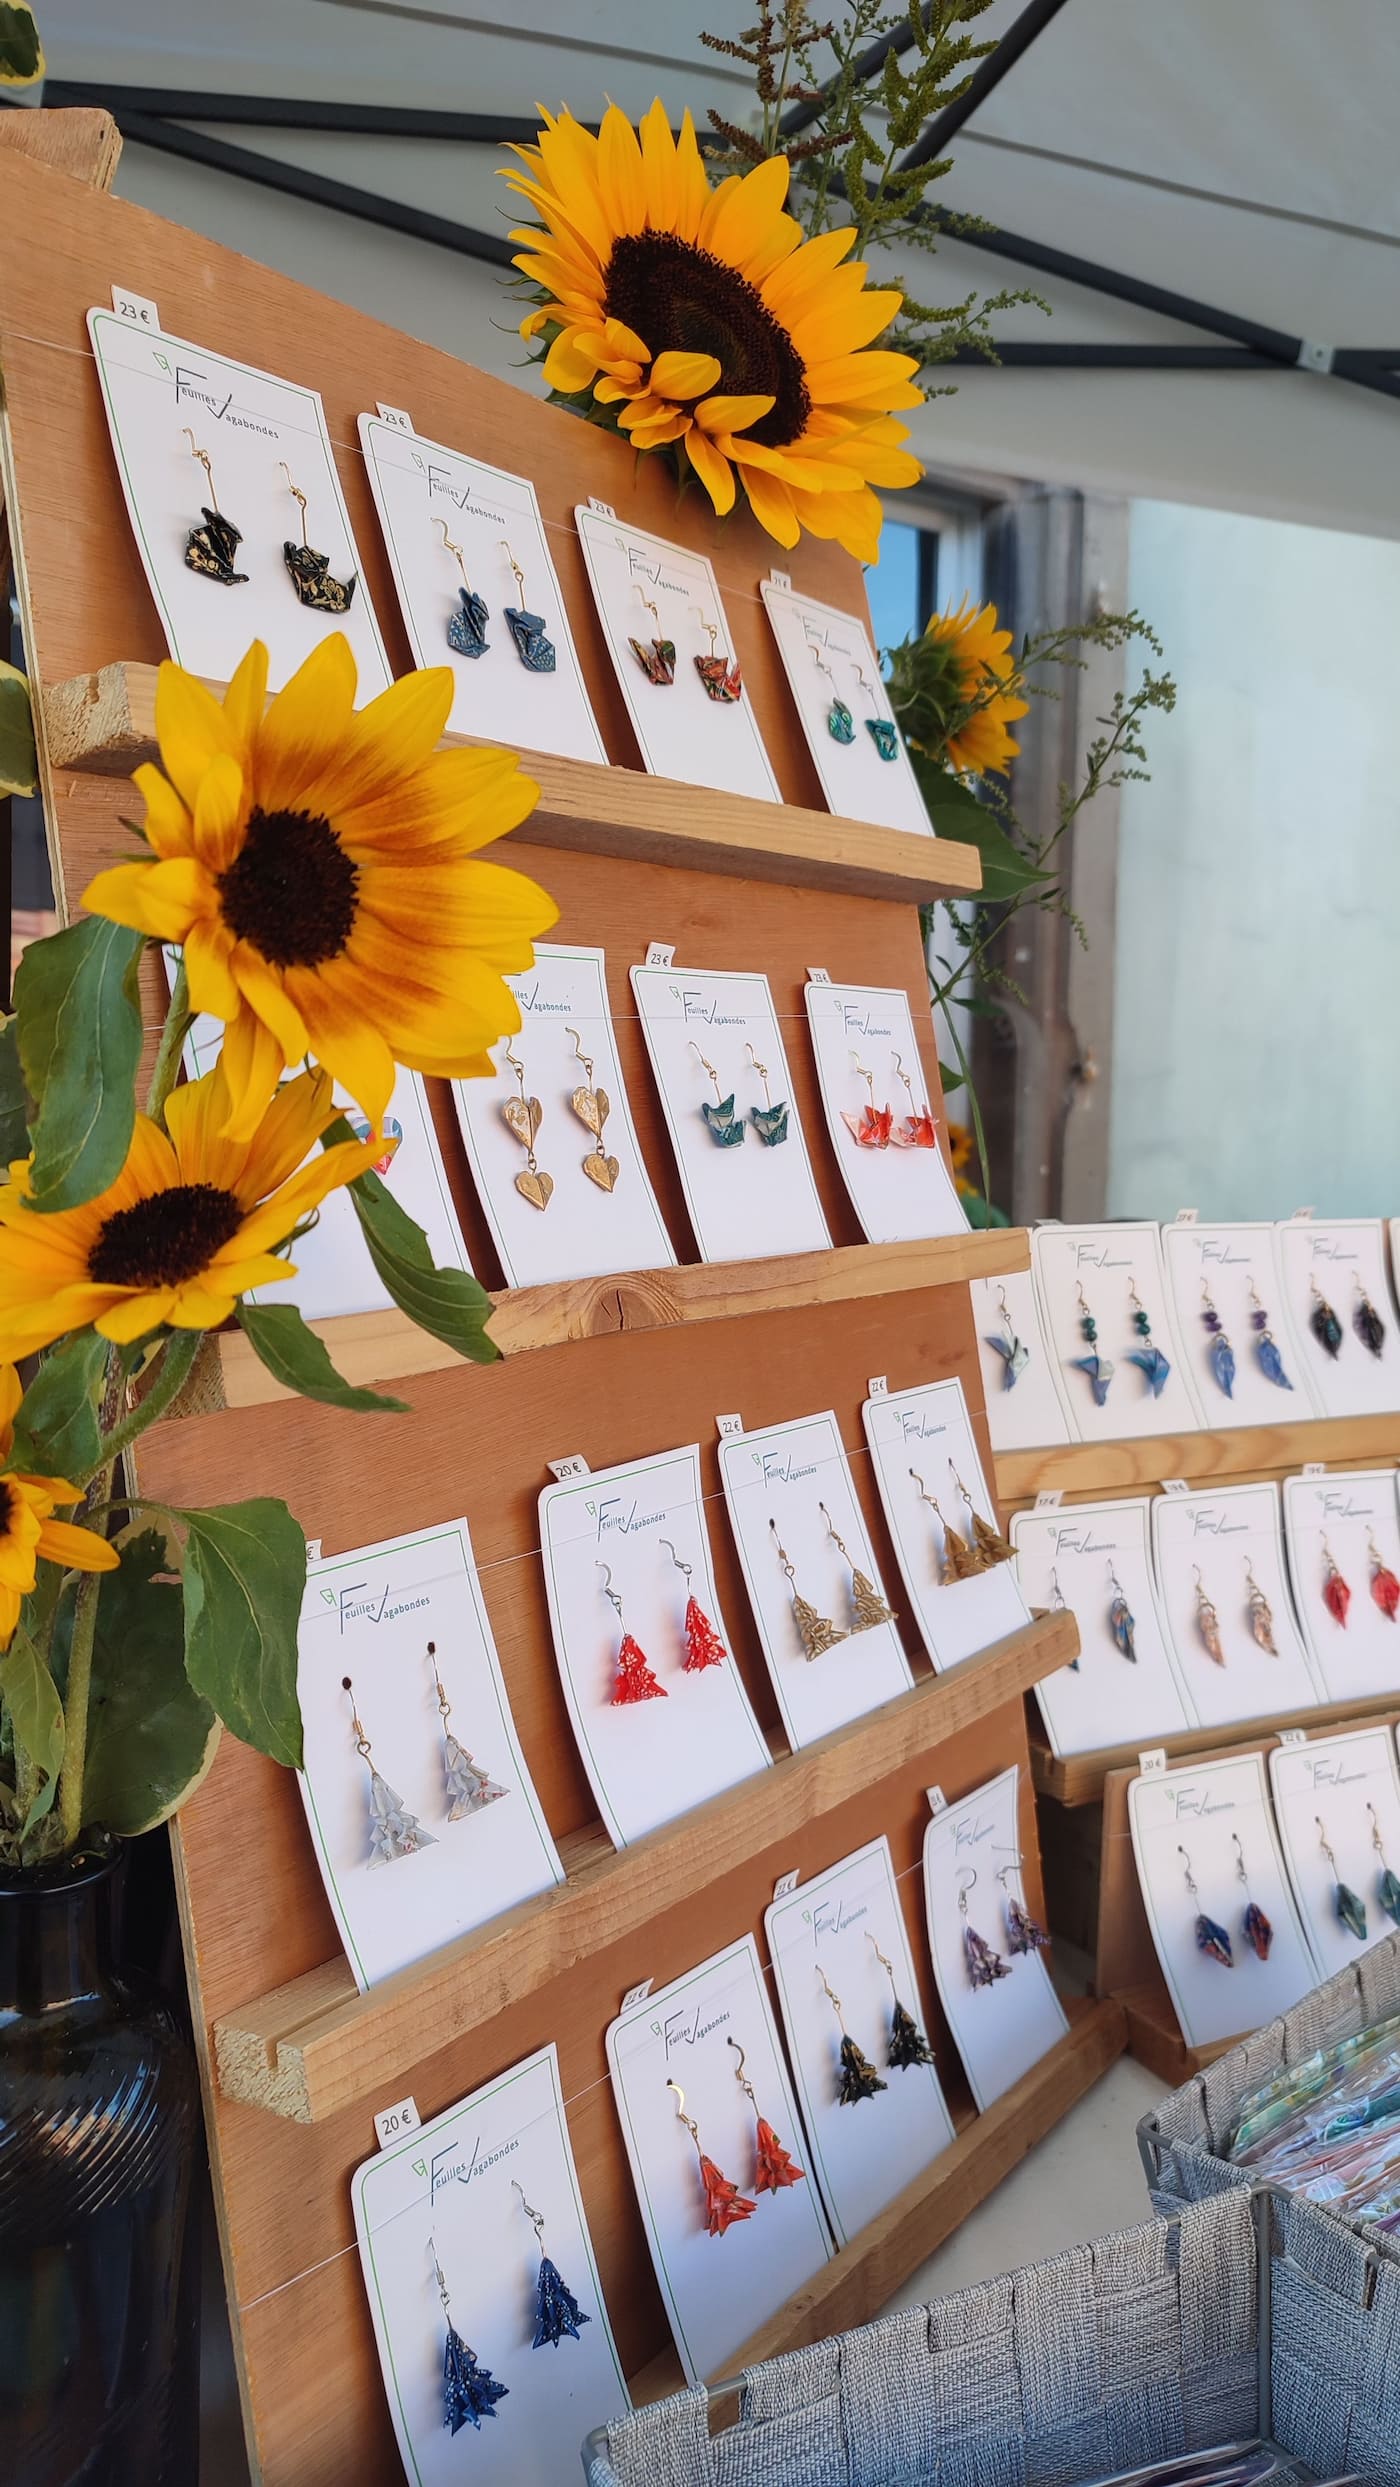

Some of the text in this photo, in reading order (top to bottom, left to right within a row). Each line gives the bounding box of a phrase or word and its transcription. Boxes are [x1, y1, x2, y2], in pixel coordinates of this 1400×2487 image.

[119, 301, 137, 319] 23
[175, 366, 280, 439] Feuilles Vagabondes
[383, 411, 398, 425] 23
[594, 500, 606, 514] 23
[650, 953, 662, 965] 23
[521, 981, 572, 1013] Vagabondes
[722, 1421, 734, 1433] 22
[556, 1465, 572, 1478] 20
[597, 1497, 667, 1543] Feuilles Vagabondes
[339, 1582, 431, 1636] Feuilles Vagabondes
[381, 2114, 400, 2136] 20
[431, 2135, 520, 2207] Feuilles Vagabondes
